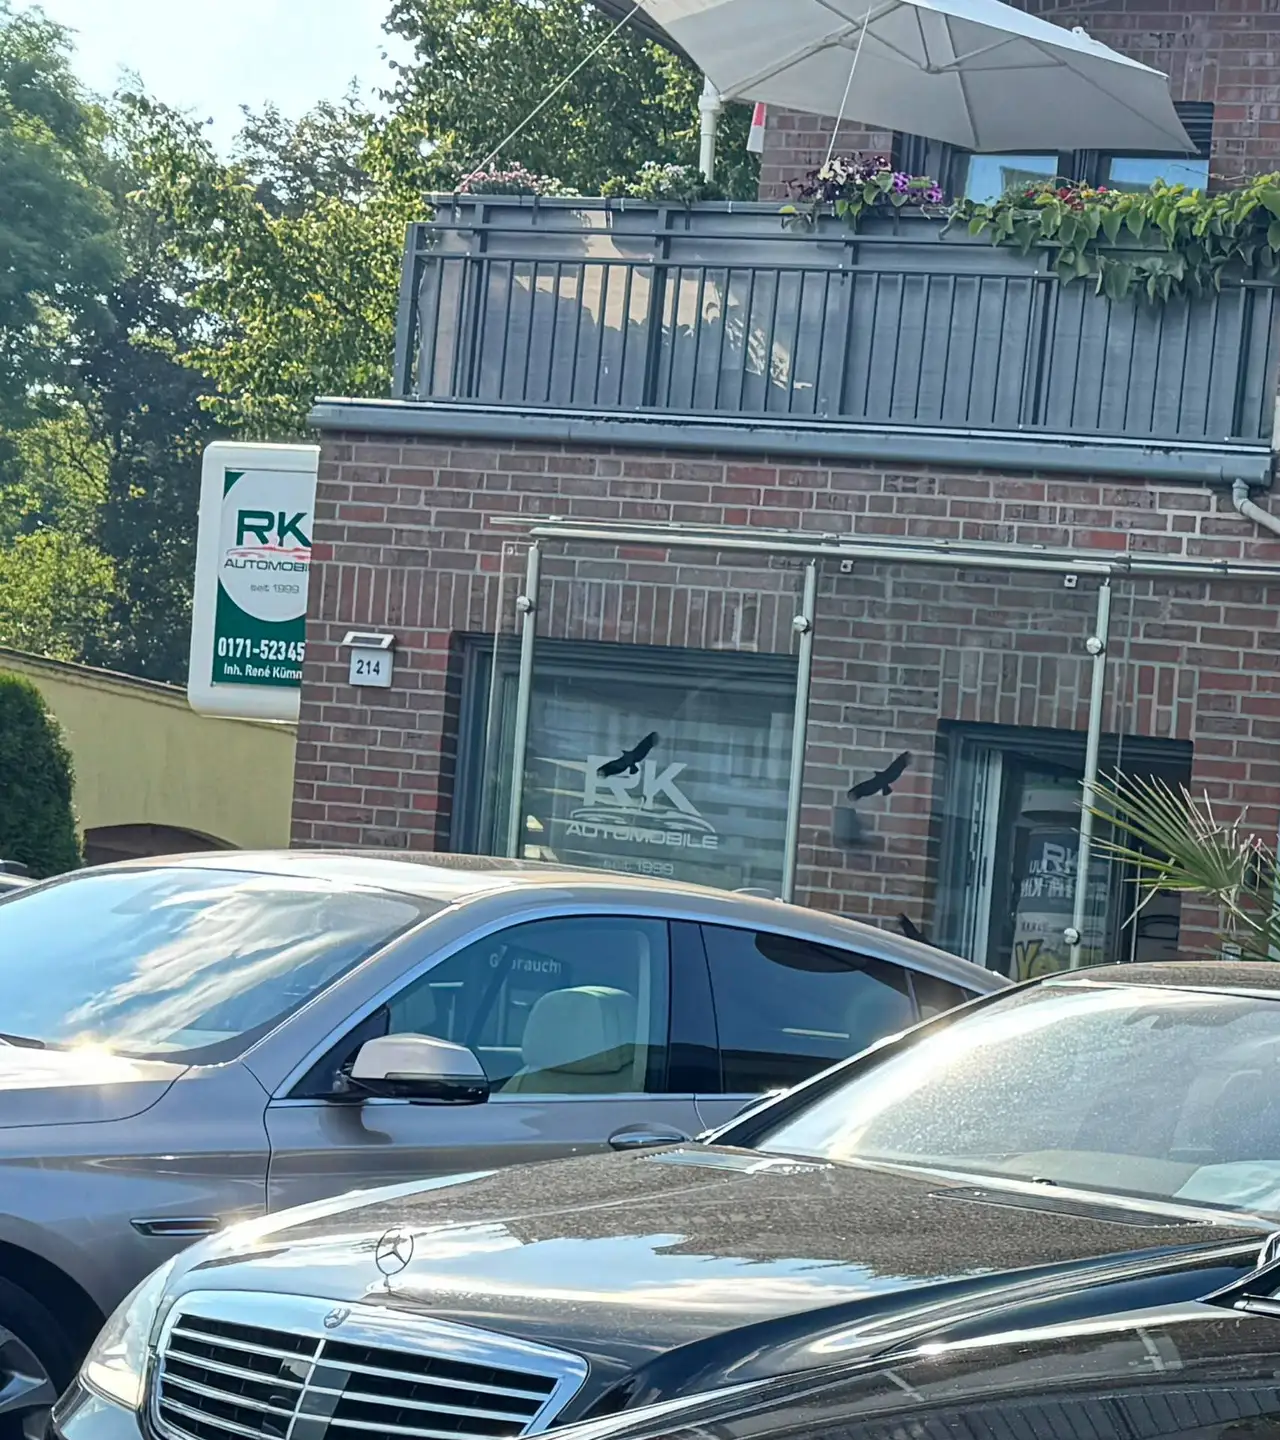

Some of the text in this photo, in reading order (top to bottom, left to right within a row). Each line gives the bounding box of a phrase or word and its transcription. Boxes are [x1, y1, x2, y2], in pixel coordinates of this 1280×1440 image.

[236, 509, 311, 548] RK
[273, 584, 300, 594] 1999
[223, 663, 243, 676] Inh.
[245, 663, 271, 678] René
[356, 659, 381, 676] 214
[583, 755, 703, 818] RK
[565, 823, 719, 850] AUTOMOBILE
